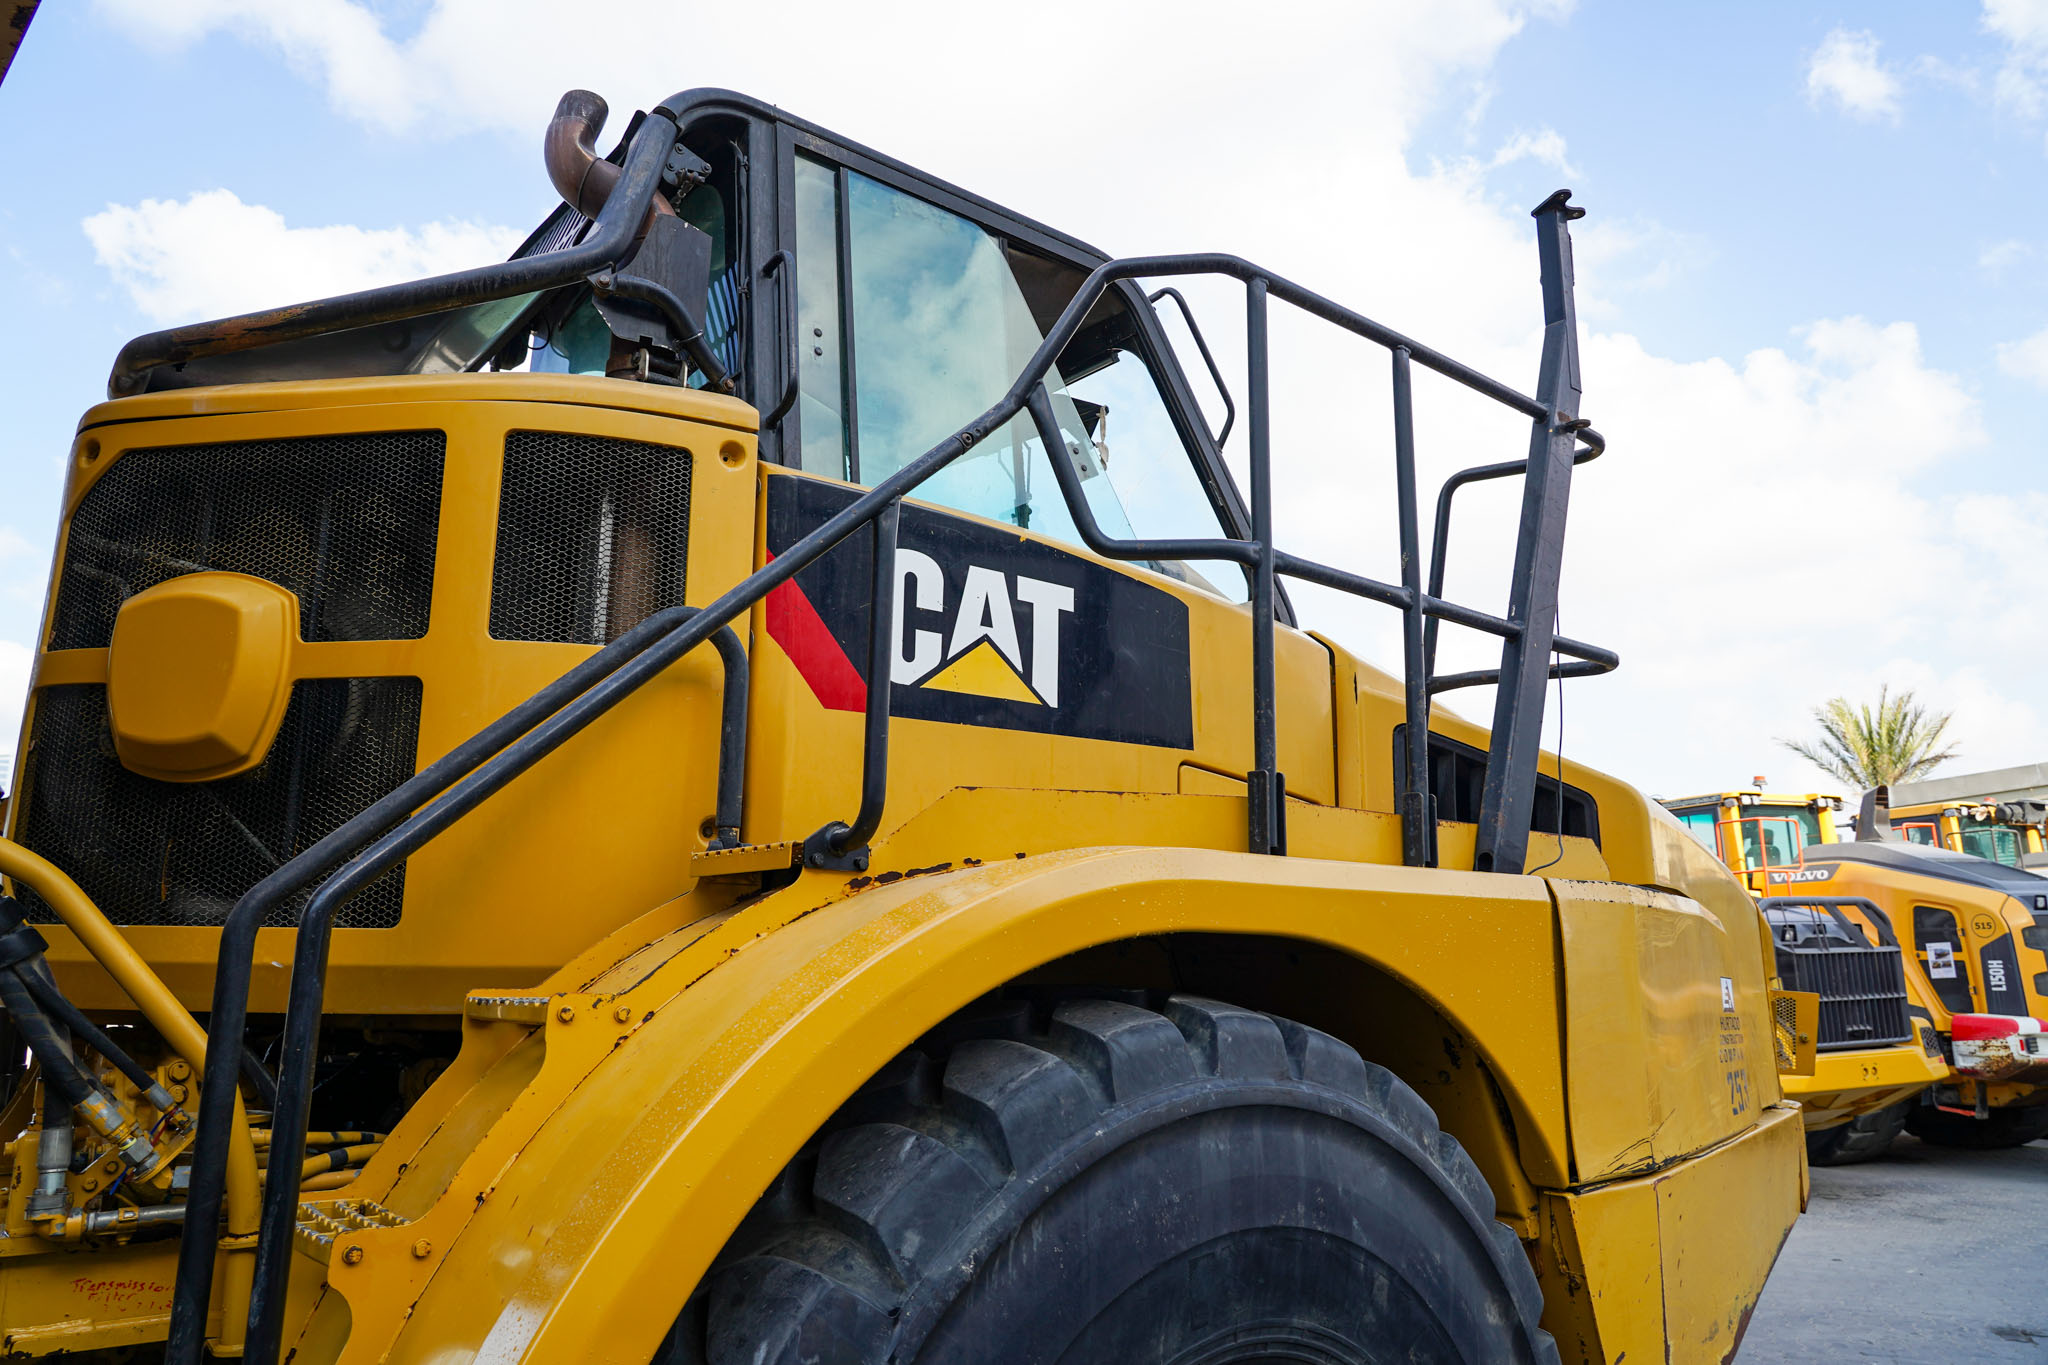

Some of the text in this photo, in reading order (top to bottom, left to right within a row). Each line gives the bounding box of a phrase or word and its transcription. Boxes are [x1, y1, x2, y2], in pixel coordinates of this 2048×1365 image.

[889, 547, 1075, 709] CAT
[1771, 869, 1829, 883] VOLVO
[1974, 921, 1993, 930] 515
[1987, 960, 2008, 992] L150H
